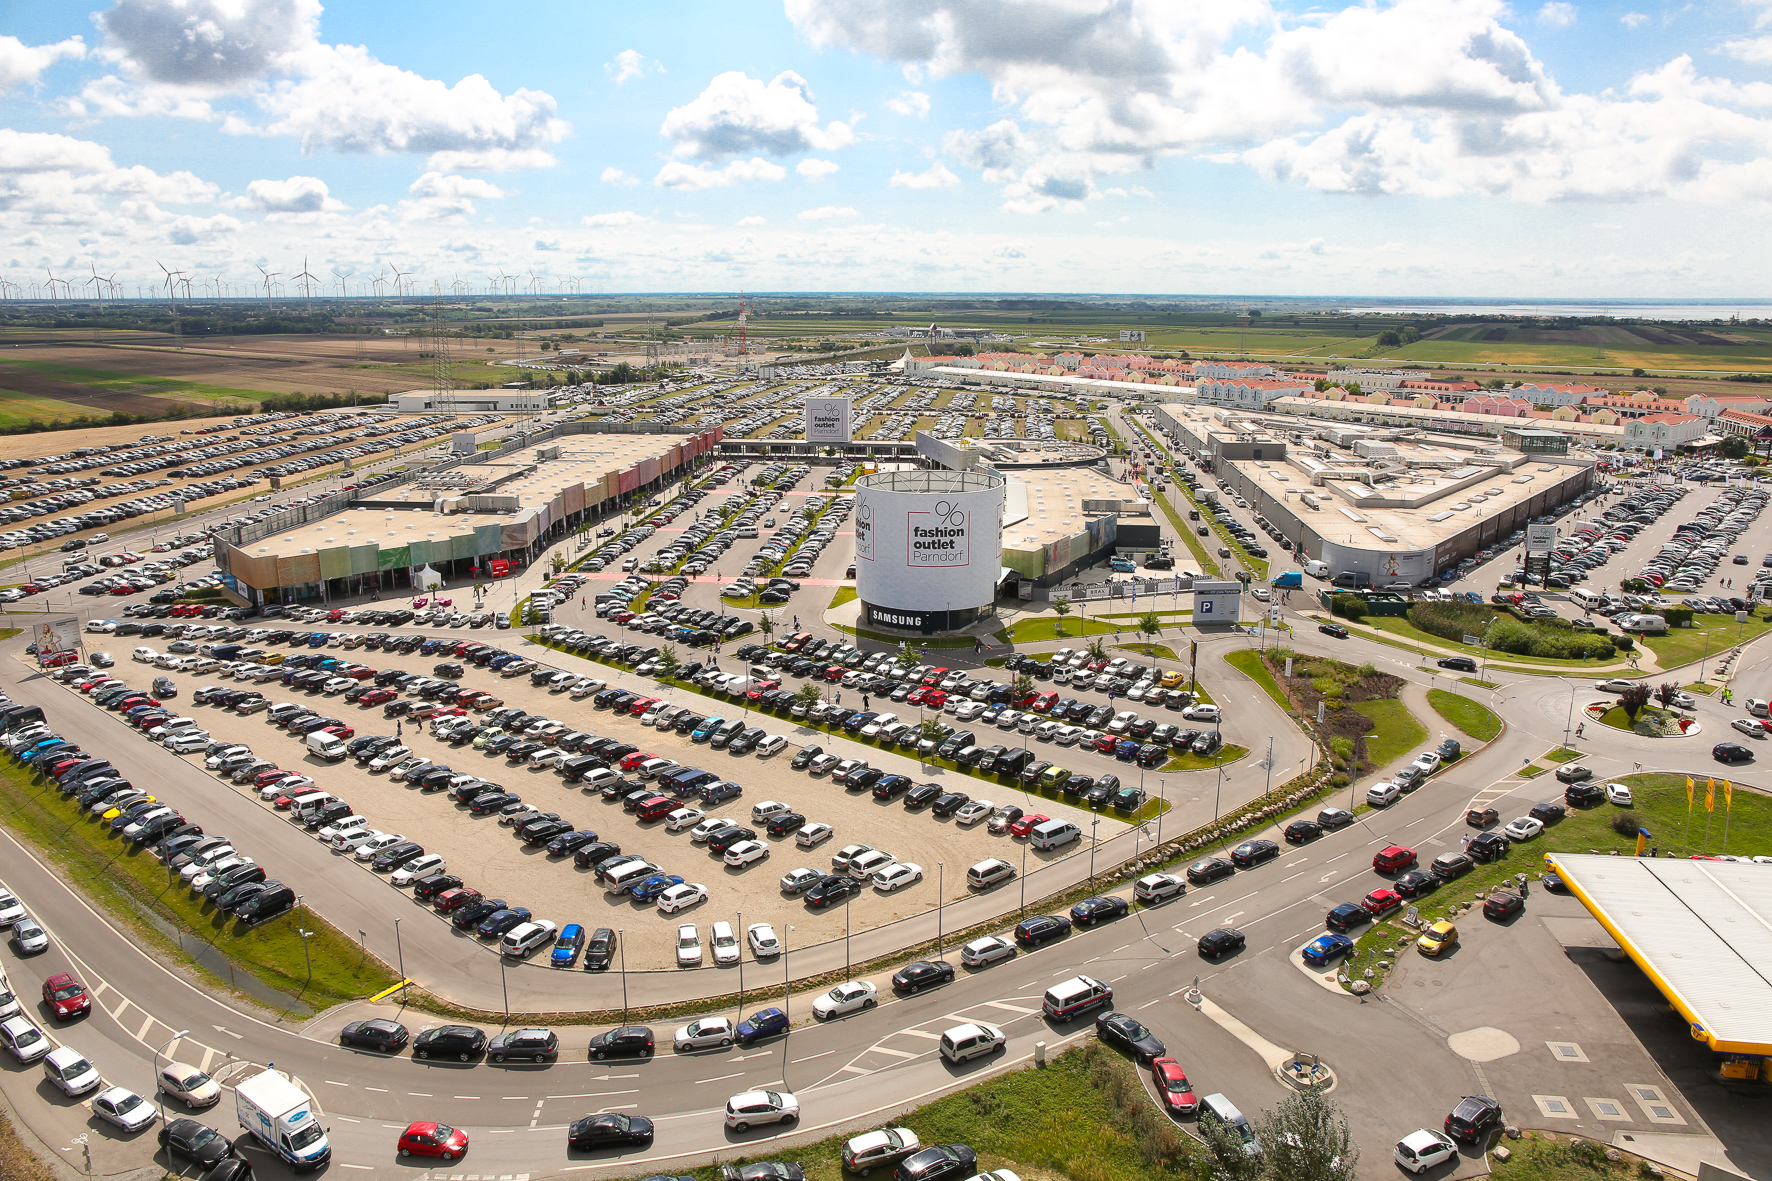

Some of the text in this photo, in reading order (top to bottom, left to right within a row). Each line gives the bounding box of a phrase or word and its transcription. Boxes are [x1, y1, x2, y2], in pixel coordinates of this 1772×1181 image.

[935, 501, 965, 526] %
[913, 526, 964, 537] fashion
[913, 538, 955, 550] outlet
[913, 550, 964, 562] Parndorf
[1202, 602, 1210, 612] P
[873, 609, 922, 626] SAMSUNG
